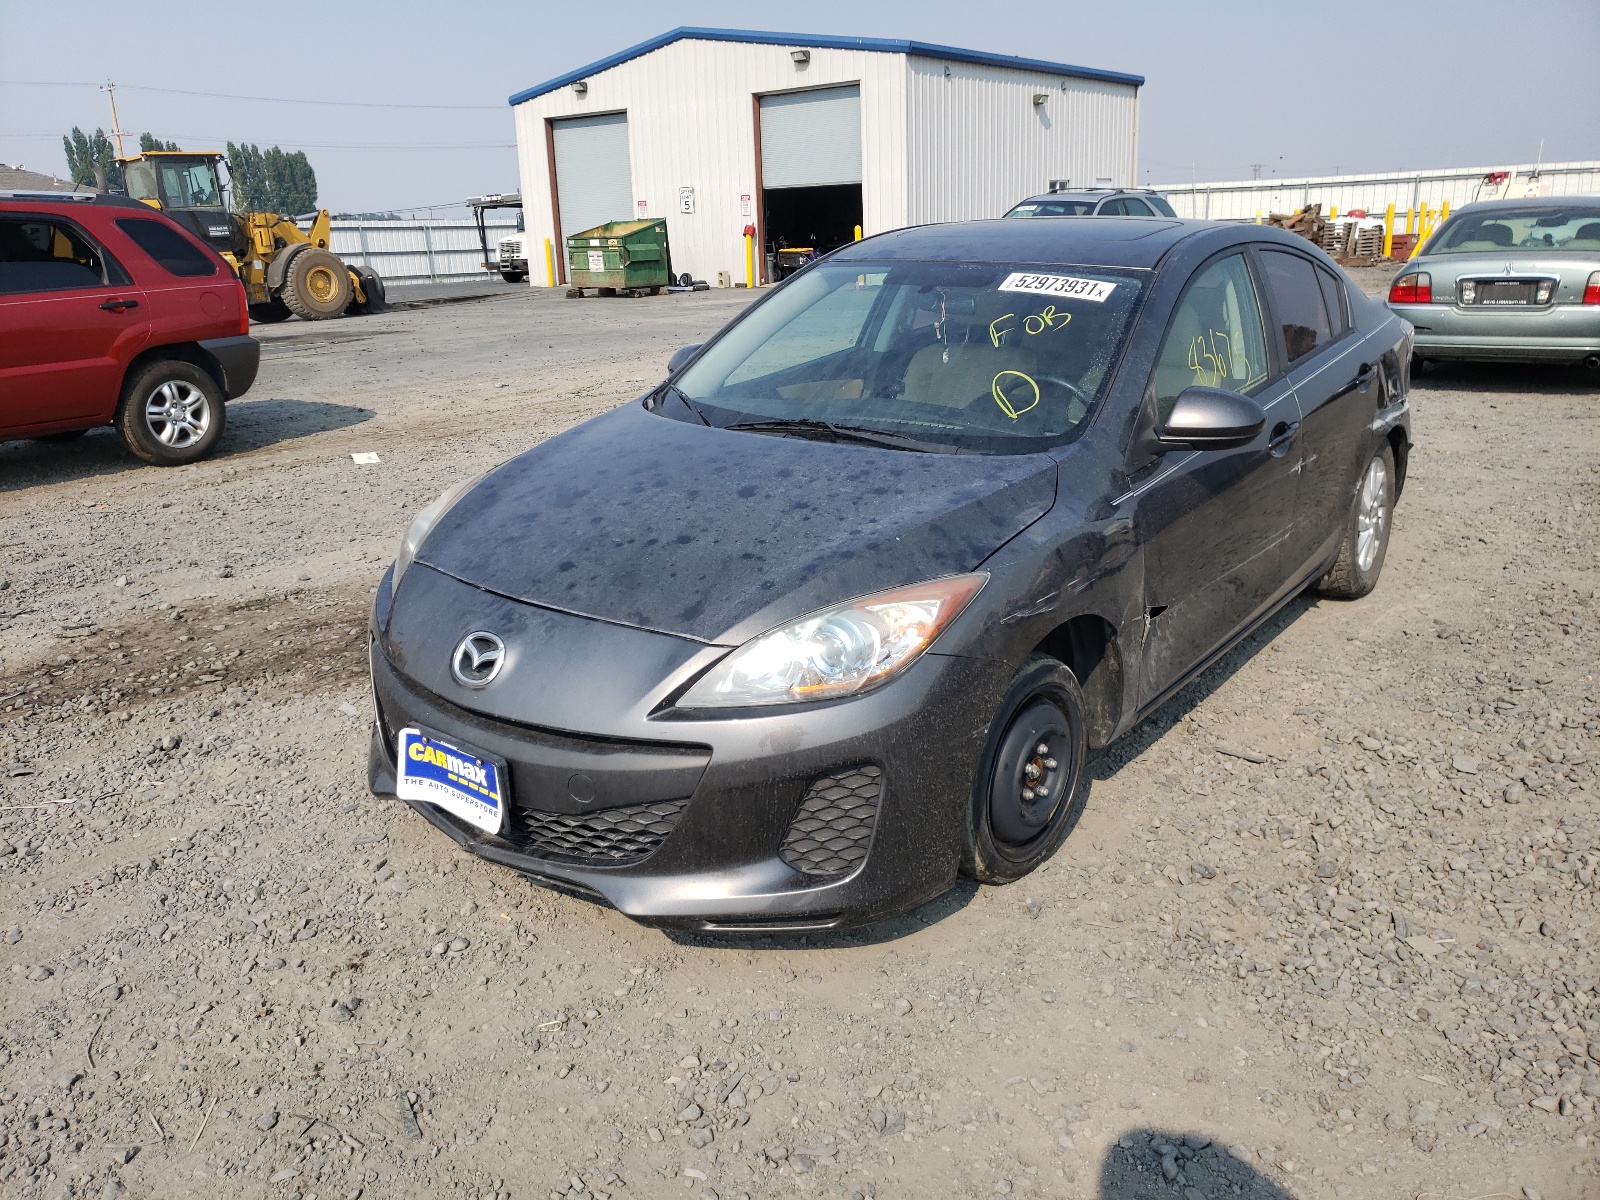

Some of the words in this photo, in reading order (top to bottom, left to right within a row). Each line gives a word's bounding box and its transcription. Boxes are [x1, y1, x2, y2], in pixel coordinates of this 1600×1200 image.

[684, 200, 691, 210] 5
[992, 370, 1040, 419] D
[404, 778, 424, 786] THE
[428, 781, 449, 794] AUTO
[451, 790, 499, 818] SUPERSTORE
